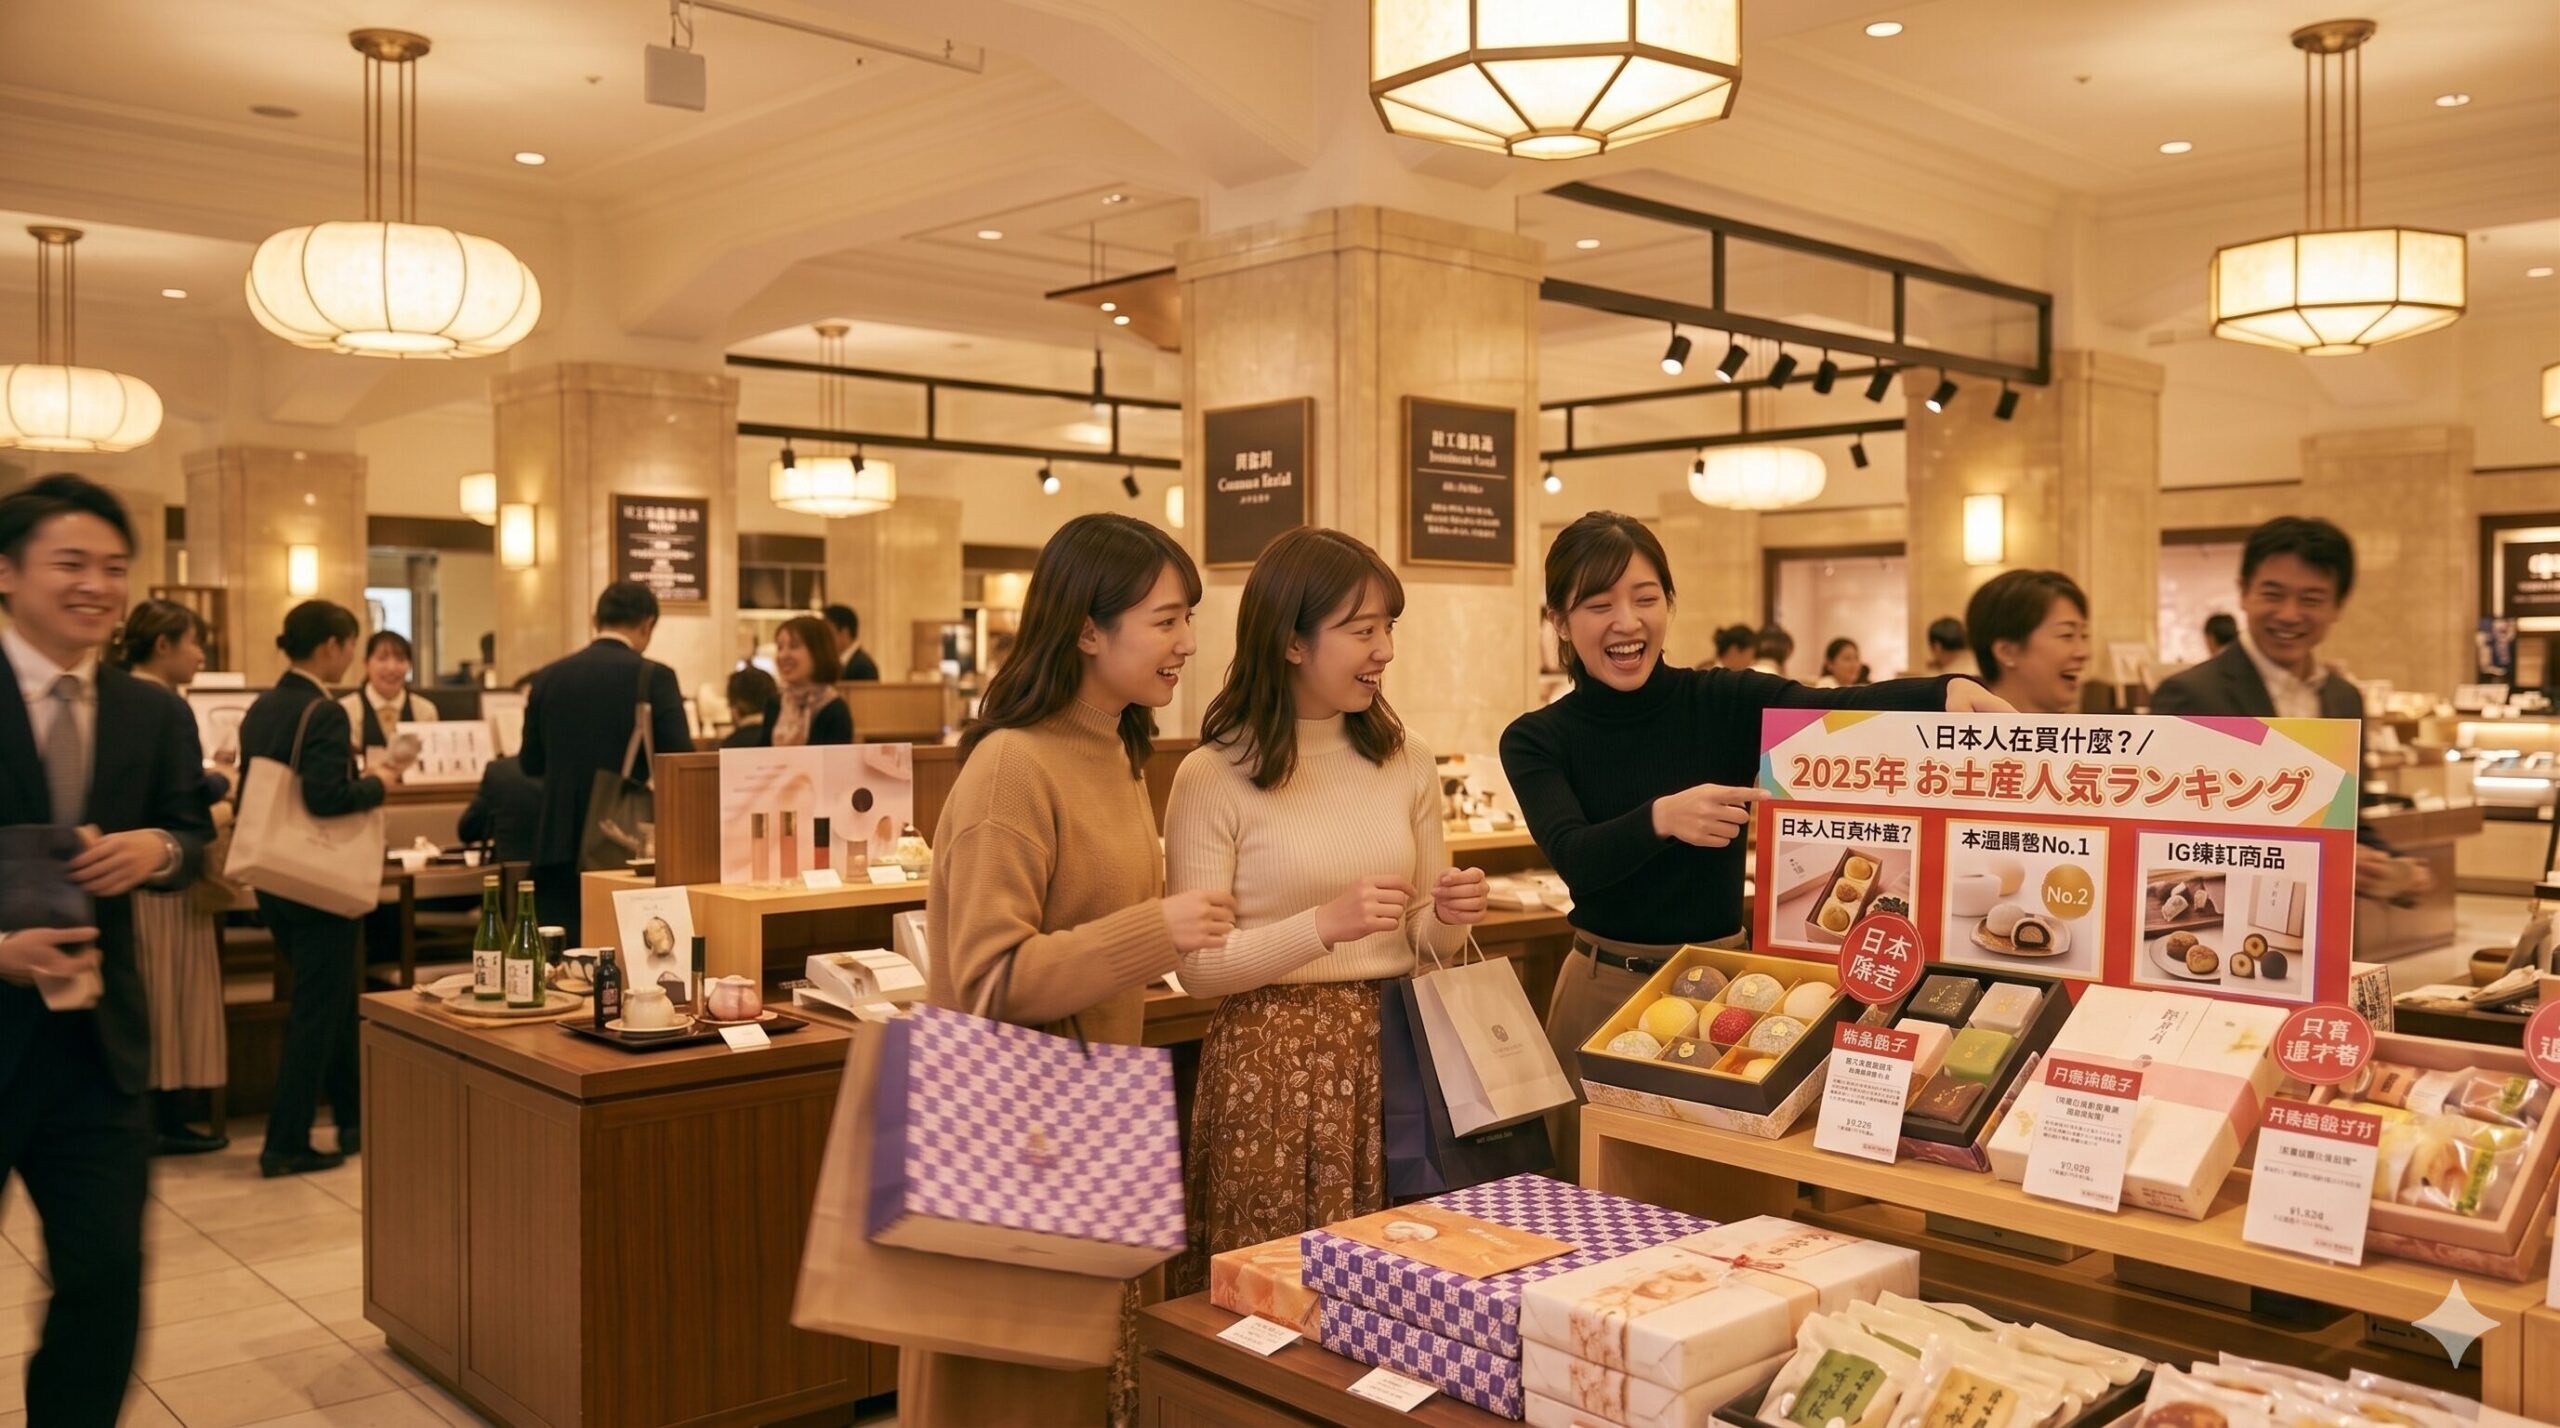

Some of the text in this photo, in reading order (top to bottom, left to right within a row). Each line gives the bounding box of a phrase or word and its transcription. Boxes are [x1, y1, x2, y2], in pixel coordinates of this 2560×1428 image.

[1936, 724, 2133, 755] 日本人在買什麼?
[1791, 755, 2311, 812] 2025年 お土産人気ランキング
[2046, 886, 2088, 905] No.2
[1860, 926, 1912, 963] 日本
